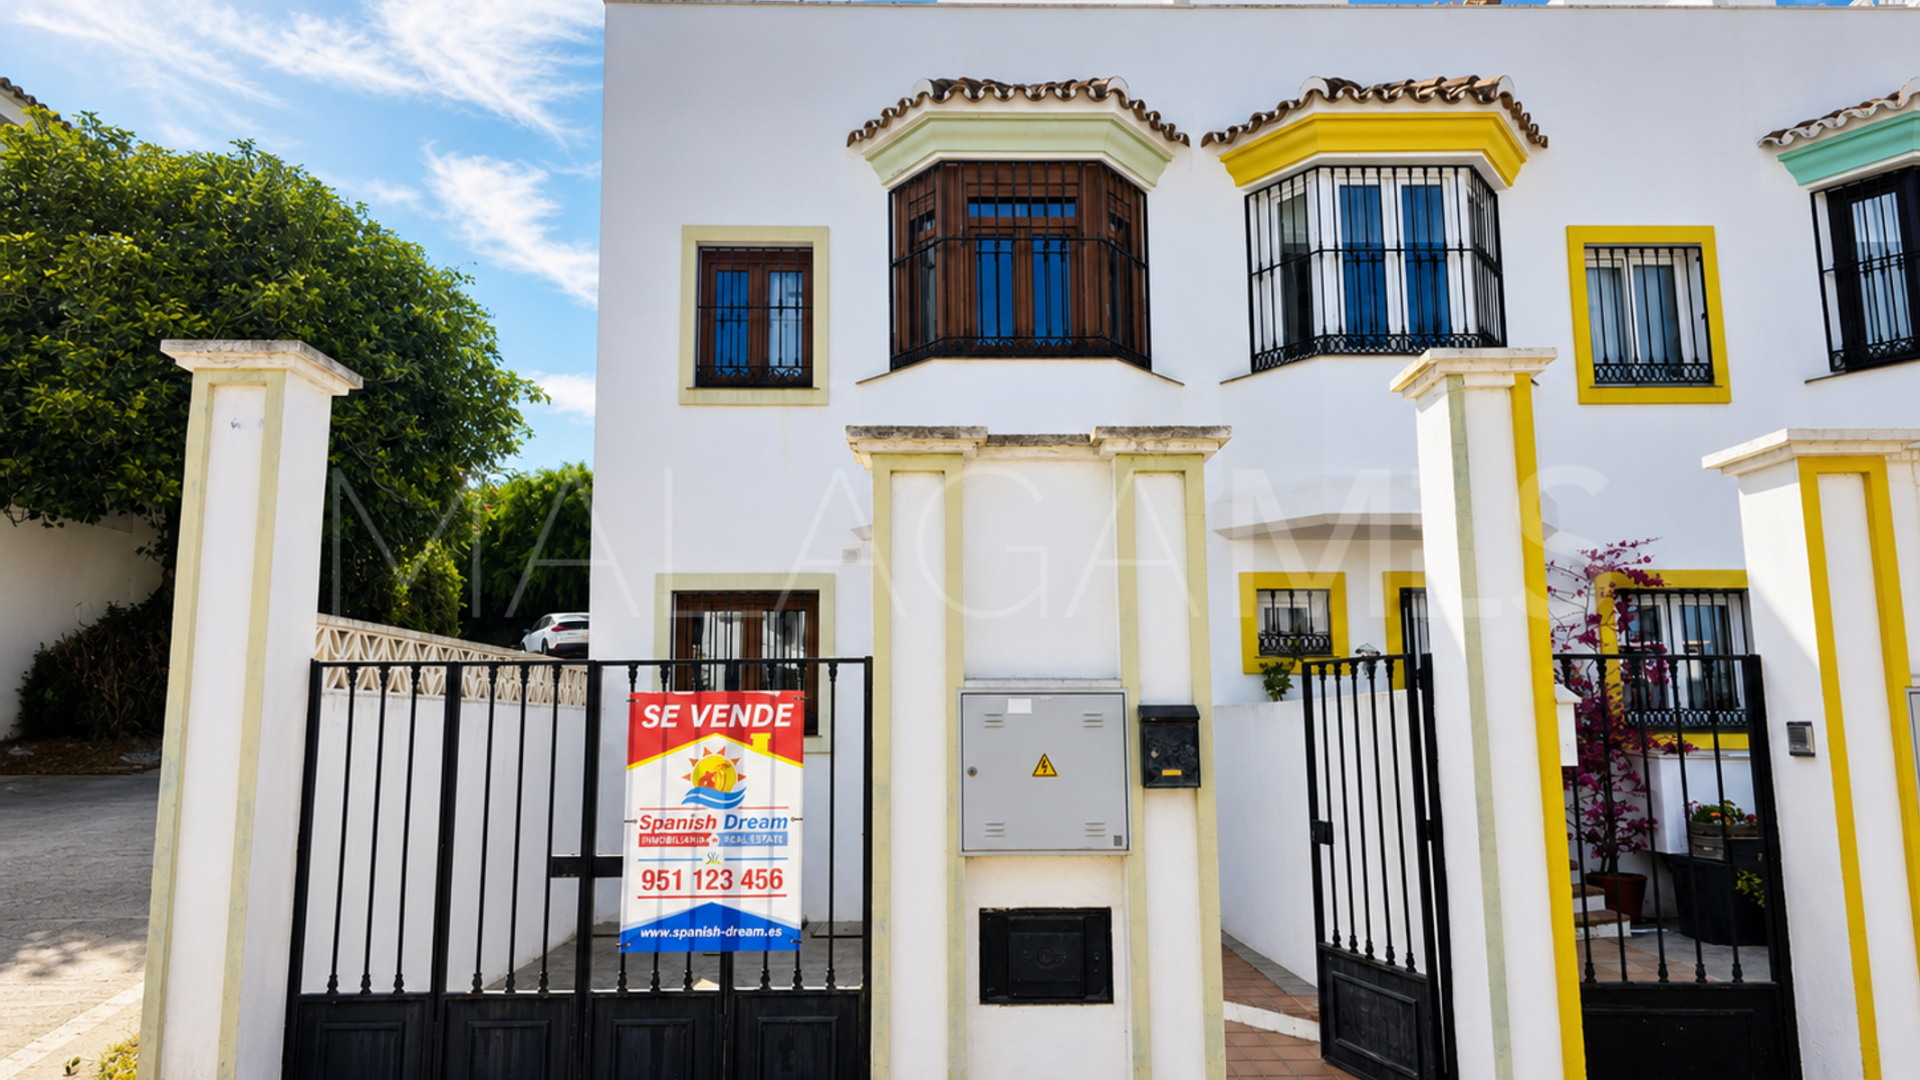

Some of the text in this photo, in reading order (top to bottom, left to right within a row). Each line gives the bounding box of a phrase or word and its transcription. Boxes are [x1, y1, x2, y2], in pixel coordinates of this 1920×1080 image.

[641, 703, 794, 729] SE VENDE
[639, 814, 788, 834] Spanish Dream
[641, 868, 784, 891] 951 123 456
[640, 925, 783, 940] www.spanish-dream.es
